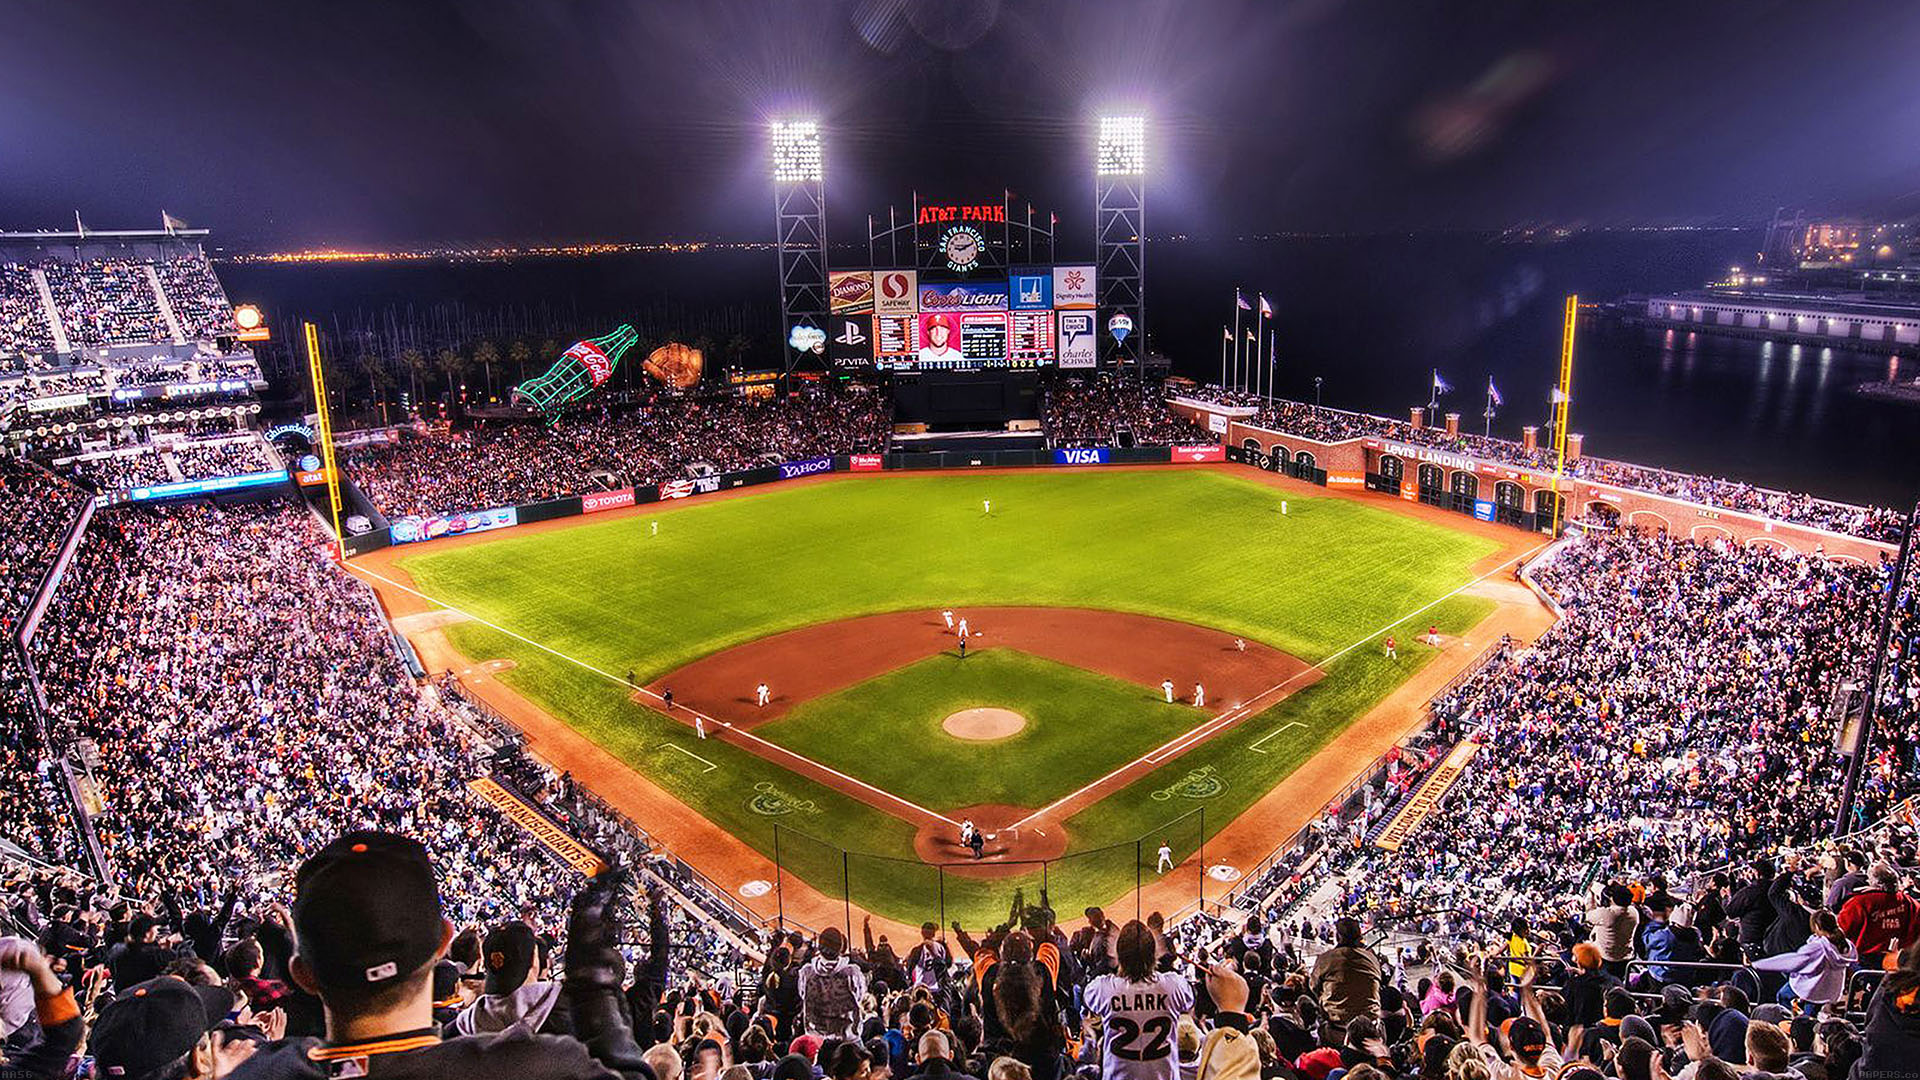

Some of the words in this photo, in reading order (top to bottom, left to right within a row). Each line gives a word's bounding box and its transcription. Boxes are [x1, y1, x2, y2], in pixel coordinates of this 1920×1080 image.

[918, 206, 957, 225] AT&T
[961, 206, 1004, 223] PARK
[939, 234, 949, 253] SAN
[947, 225, 986, 252] FRANCISCO
[946, 260, 979, 273] GIANTS
[833, 282, 870, 297] DIAMOND
[922, 289, 961, 308] Coors
[962, 294, 1005, 305] LIGHT
[264, 423, 314, 442] Ghirardelli
[1063, 450, 1100, 463] VISA
[1419, 450, 1475, 471] LANDING
[782, 459, 831, 478] YAHOO!
[598, 493, 634, 505] TOYOTA
[1383, 806, 1423, 844] WELCOME
[1436, 765, 1458, 785] PARK
[485, 788, 510, 807] SAN
[505, 803, 552, 836] FRANCISCO
[546, 832, 586, 862] GIANTS
[1111, 993, 1168, 1012] CLARK
[1108, 1015, 1173, 1062] 22
